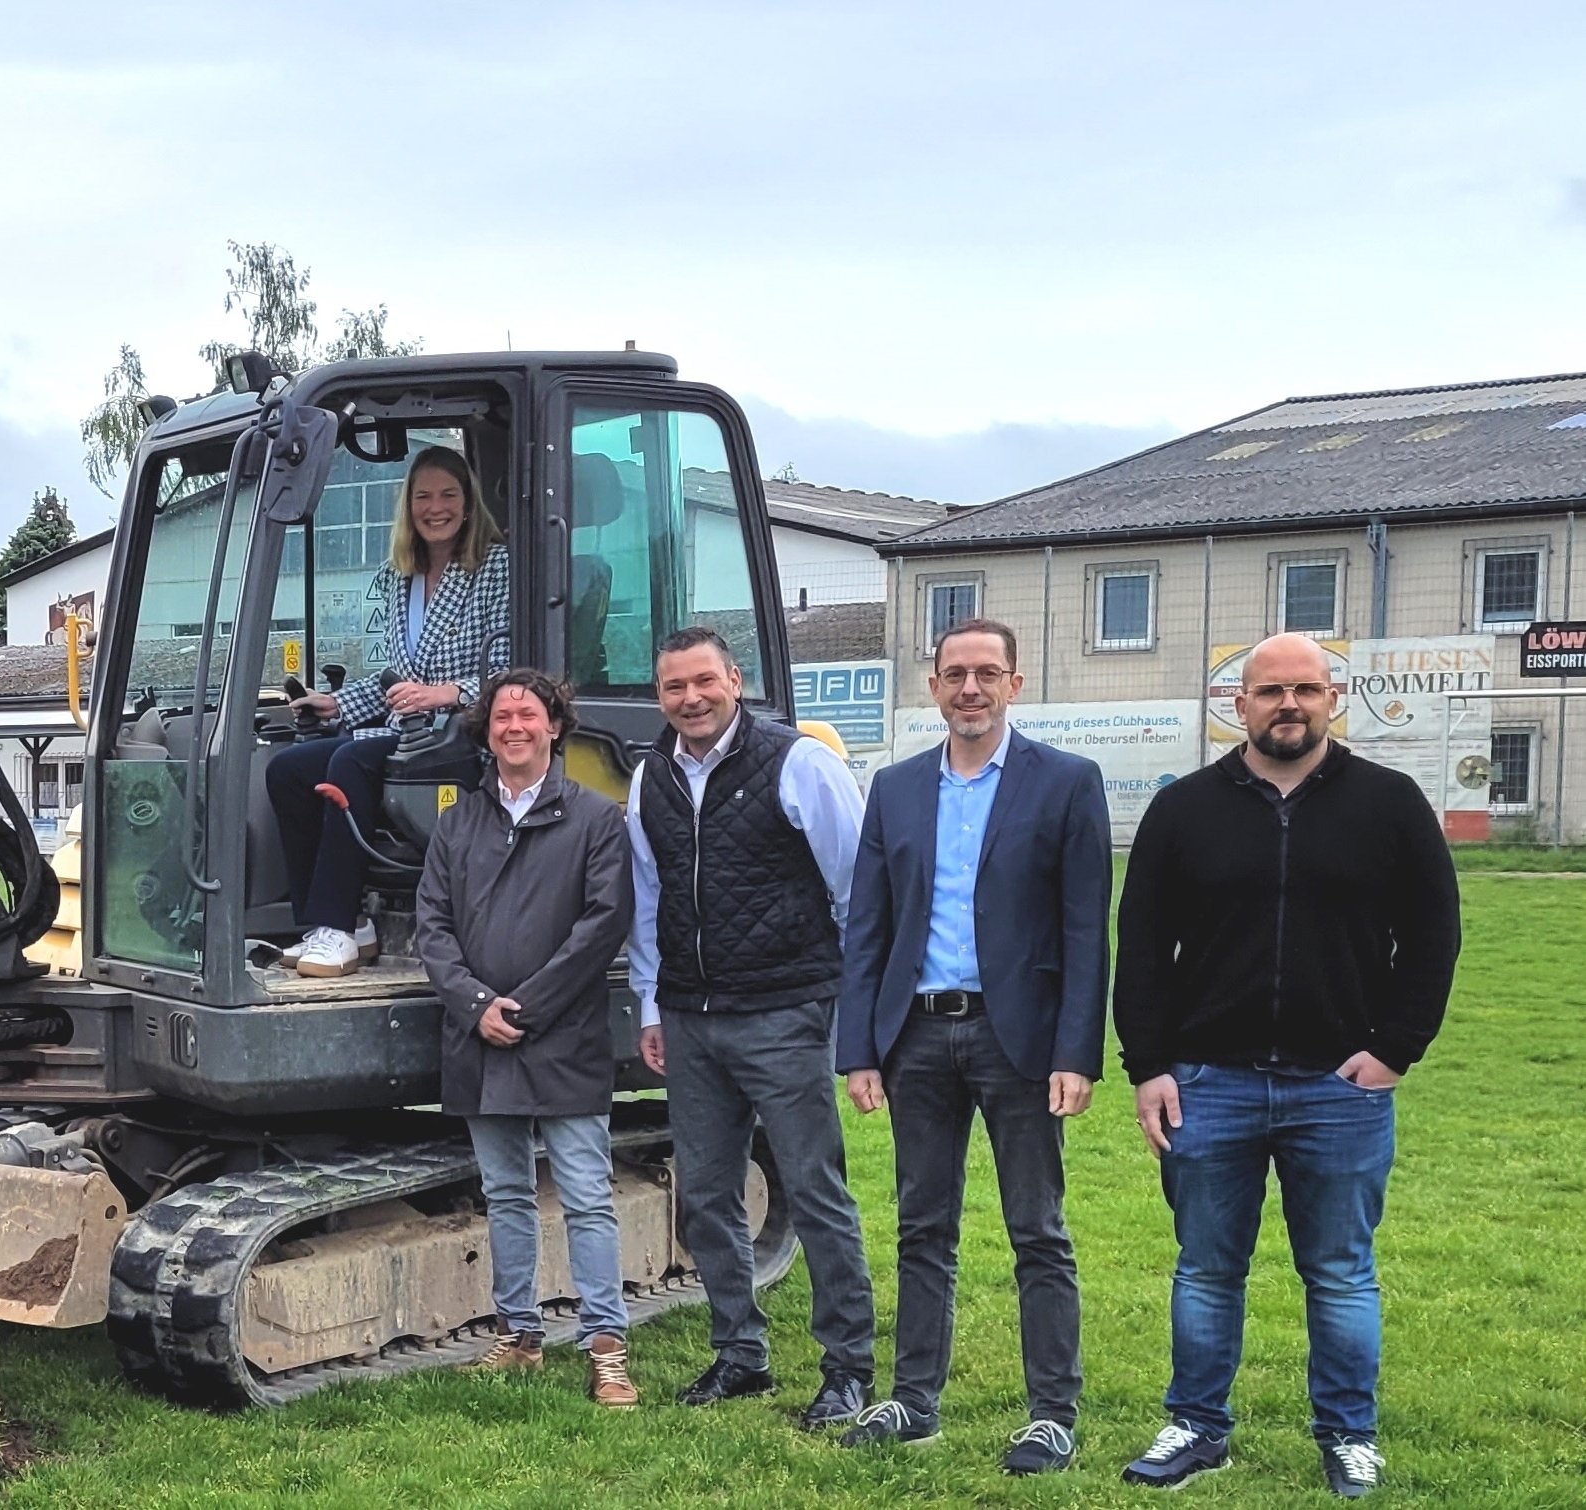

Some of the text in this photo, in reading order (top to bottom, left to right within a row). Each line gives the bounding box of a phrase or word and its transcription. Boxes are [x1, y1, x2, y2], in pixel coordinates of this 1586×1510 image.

[1528, 627, 1586, 650] LÖW
[1370, 649, 1492, 672] FLIESEN
[1526, 653, 1586, 668] EISSPORT
[1220, 687, 1242, 696] DRA
[1351, 671, 1491, 696] RÖMMELT
[908, 715, 1182, 732] Wir unte Sanierung dieses Clubhauses,
[1065, 737, 1083, 745] wir
[1085, 733, 1139, 745] Oberursel
[1141, 732, 1181, 744] lieben!
[848, 760, 868, 770] ice
